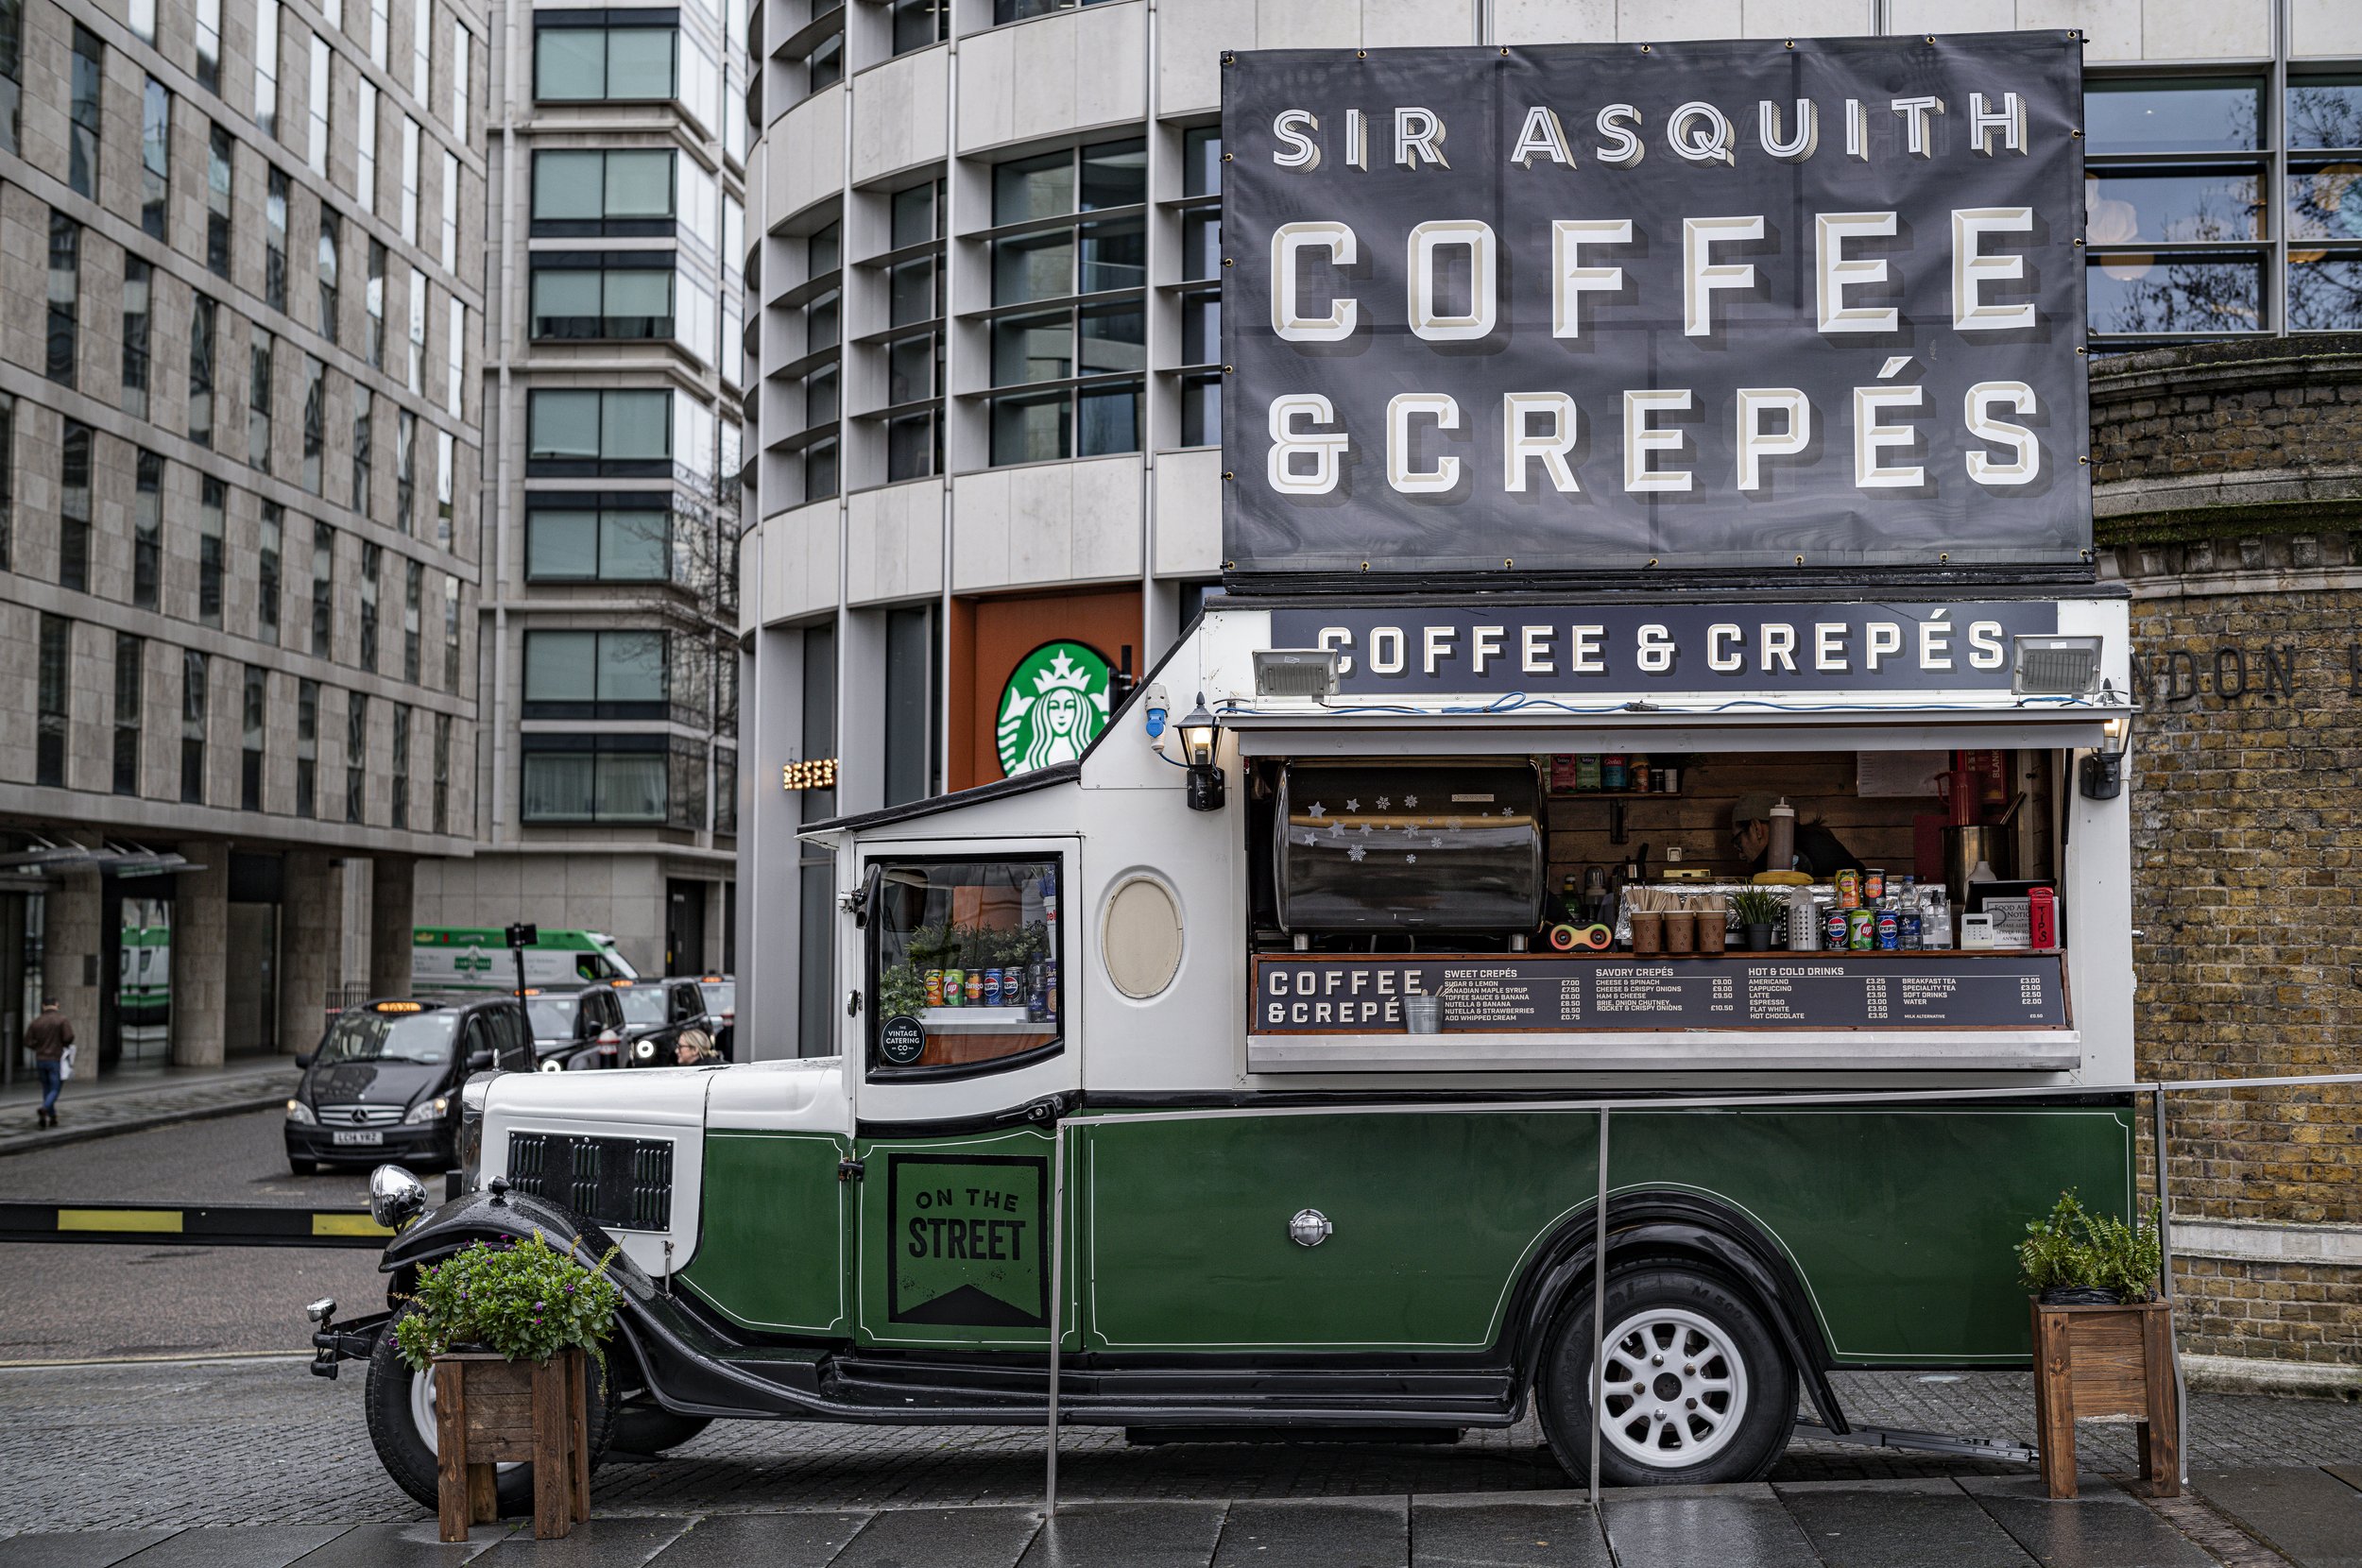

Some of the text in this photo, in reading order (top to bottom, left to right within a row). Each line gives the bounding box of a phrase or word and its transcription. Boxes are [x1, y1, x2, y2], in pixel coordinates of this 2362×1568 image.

[1273, 91, 2029, 173] SIR ASQUITH
[1270, 206, 2036, 344] COFFEE
[1318, 608, 2004, 673] COFFEE & CREPÉS
[2037, 907, 2047, 942] TIPS
[1269, 969, 1422, 996] COFFEE
[1481, 968, 1517, 978] CREPÉS
[1596, 966, 1673, 977] SAVORY CREPÉS
[1807, 967, 1843, 976] DRINKS
[916, 1188, 1018, 1213] ON THE
[909, 1217, 1026, 1260] STREET
